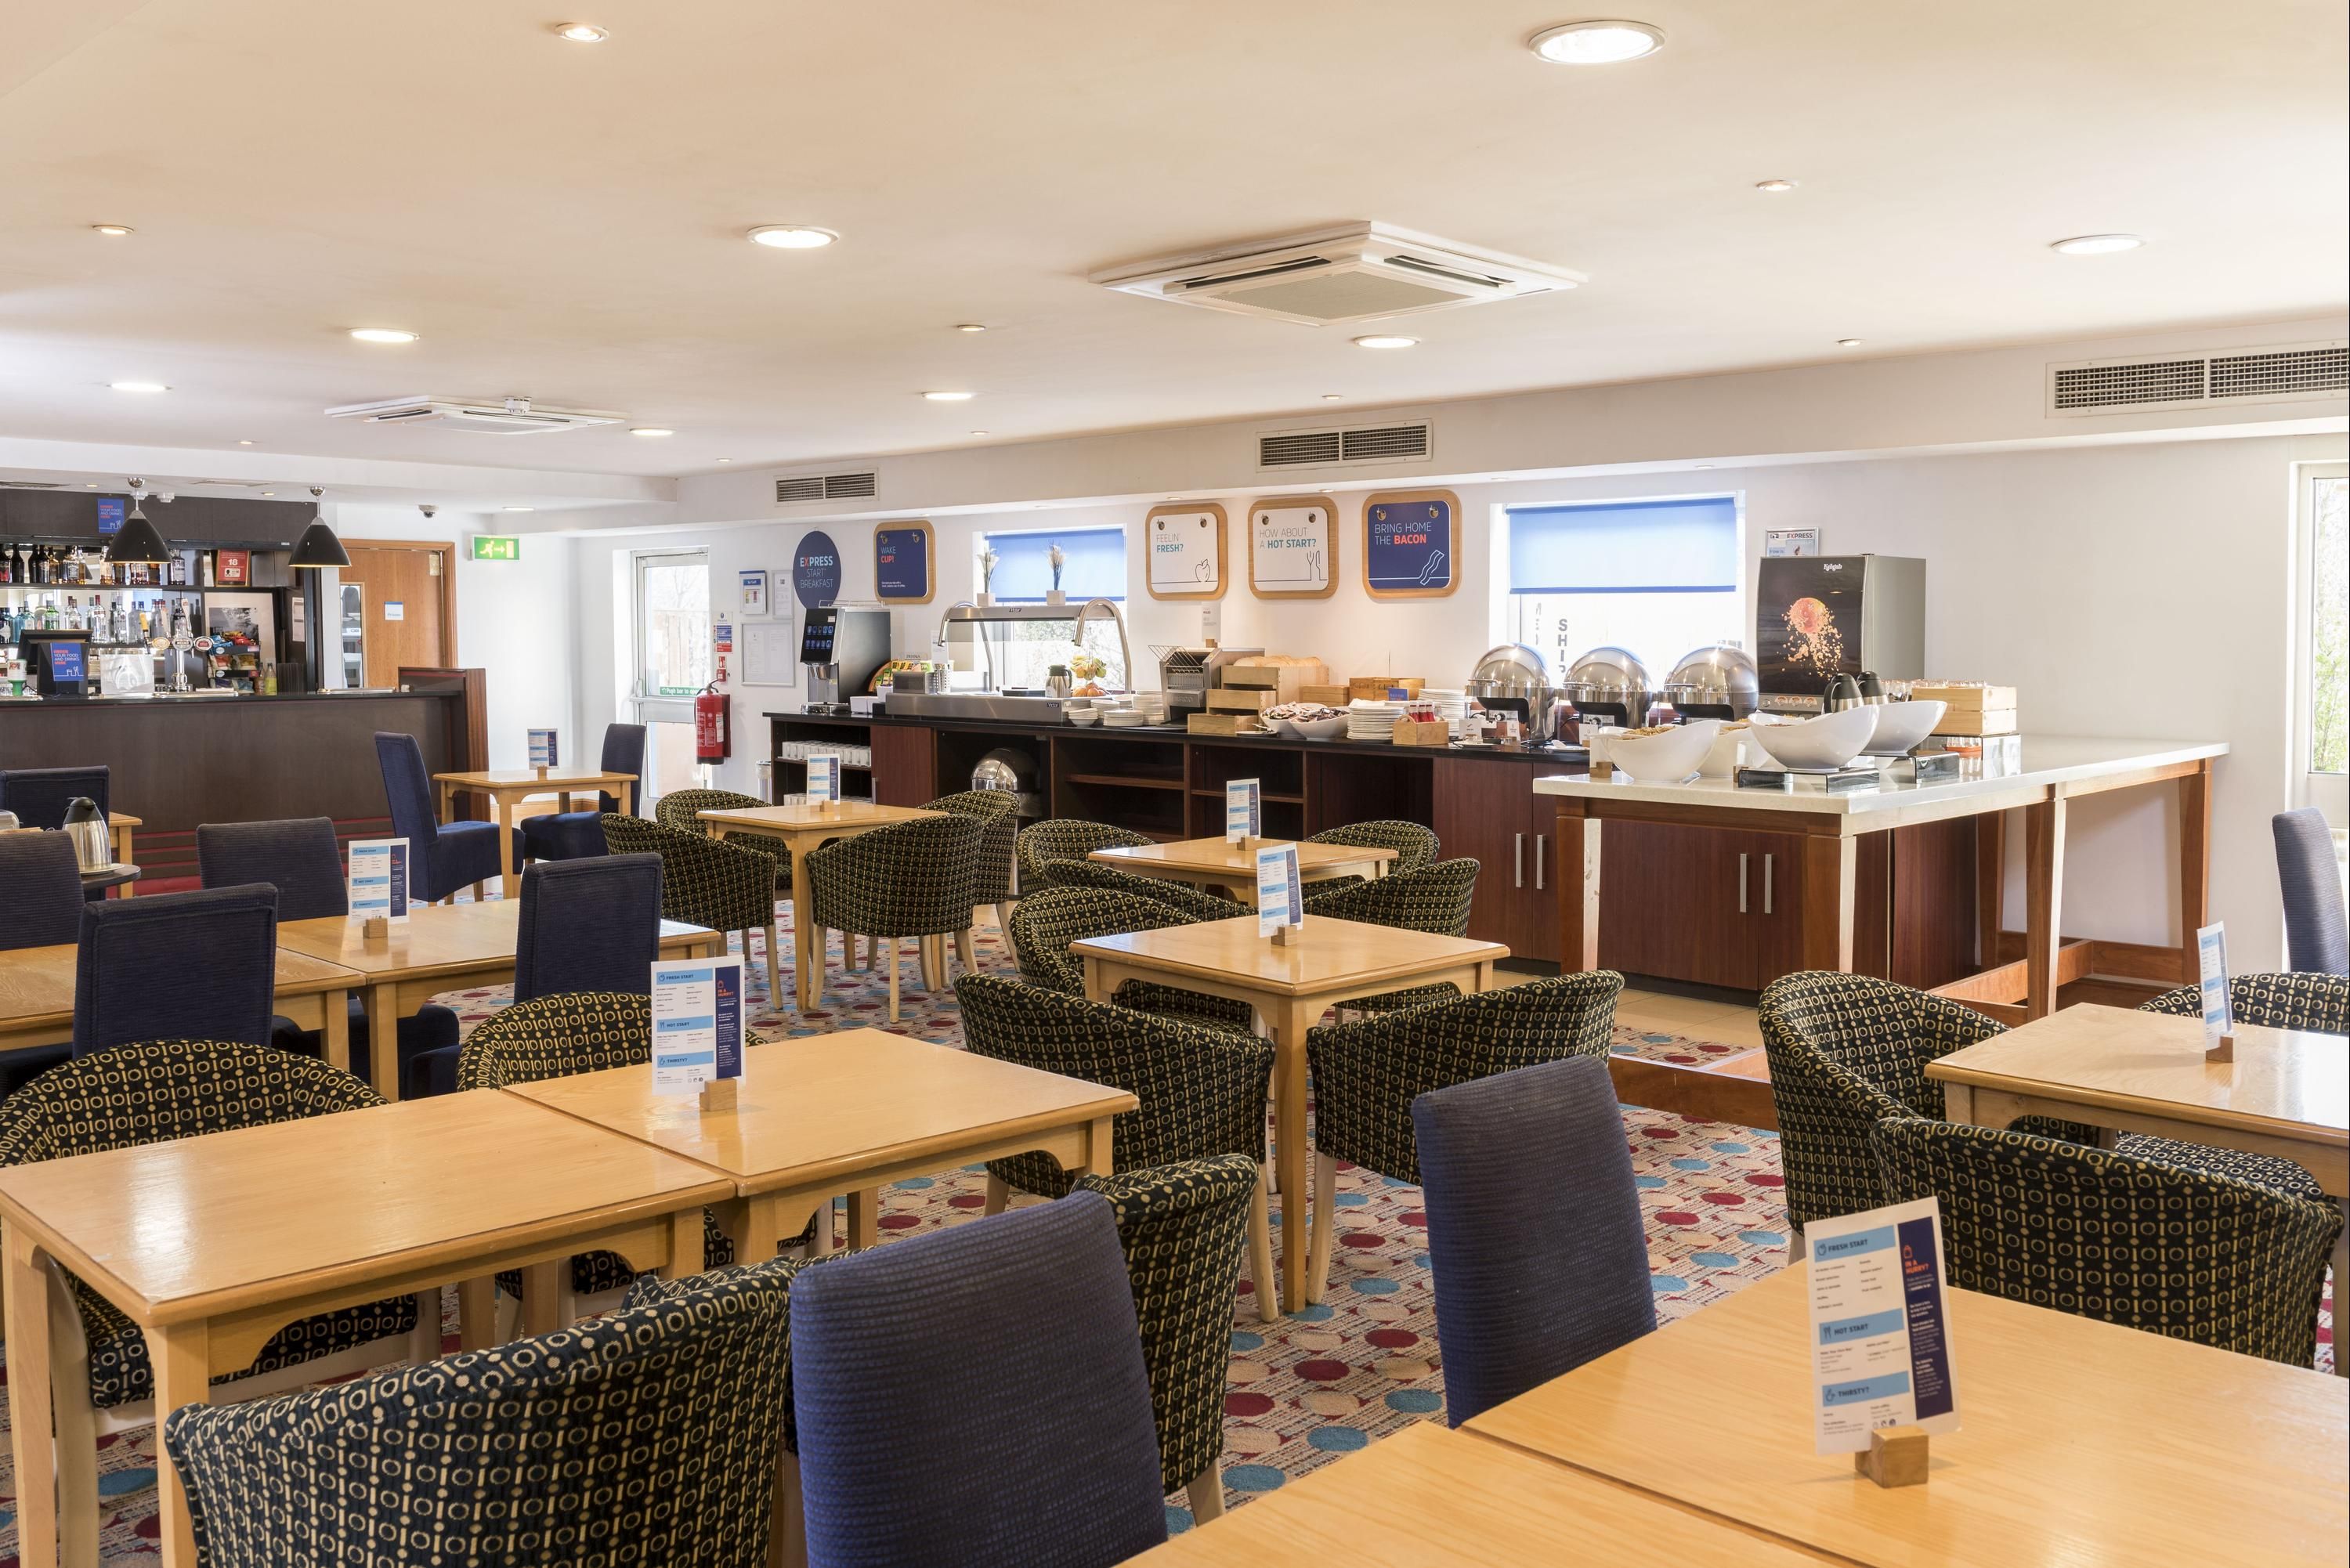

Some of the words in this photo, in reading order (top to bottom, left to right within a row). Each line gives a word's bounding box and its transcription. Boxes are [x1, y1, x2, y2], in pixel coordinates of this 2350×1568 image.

[1260, 529, 1278, 538] HOW
[1281, 527, 1307, 537] ABOUT
[1375, 522, 1402, 533] BRING
[1405, 522, 1432, 533] HOME
[1260, 540, 1265, 549] A
[1267, 540, 1284, 549] HOT
[1286, 538, 1317, 547] START?
[1375, 535, 1391, 545] THE
[1394, 534, 1426, 544] BACON
[881, 545, 896, 555] WAKE
[1156, 544, 1184, 553] FRESH?
[800, 555, 833, 567] EXPRESS
[881, 555, 895, 563] CUP!
[800, 578, 834, 589] BREAKFAST
[1828, 1241, 1849, 1252] FRESH
[1849, 1238, 1868, 1249] START
[1905, 1263, 1930, 1275] HURRY?
[1834, 1325, 1849, 1335] HOT
[1849, 1323, 1869, 1333] START
[1838, 1386, 1870, 1397] THIRSTY?
